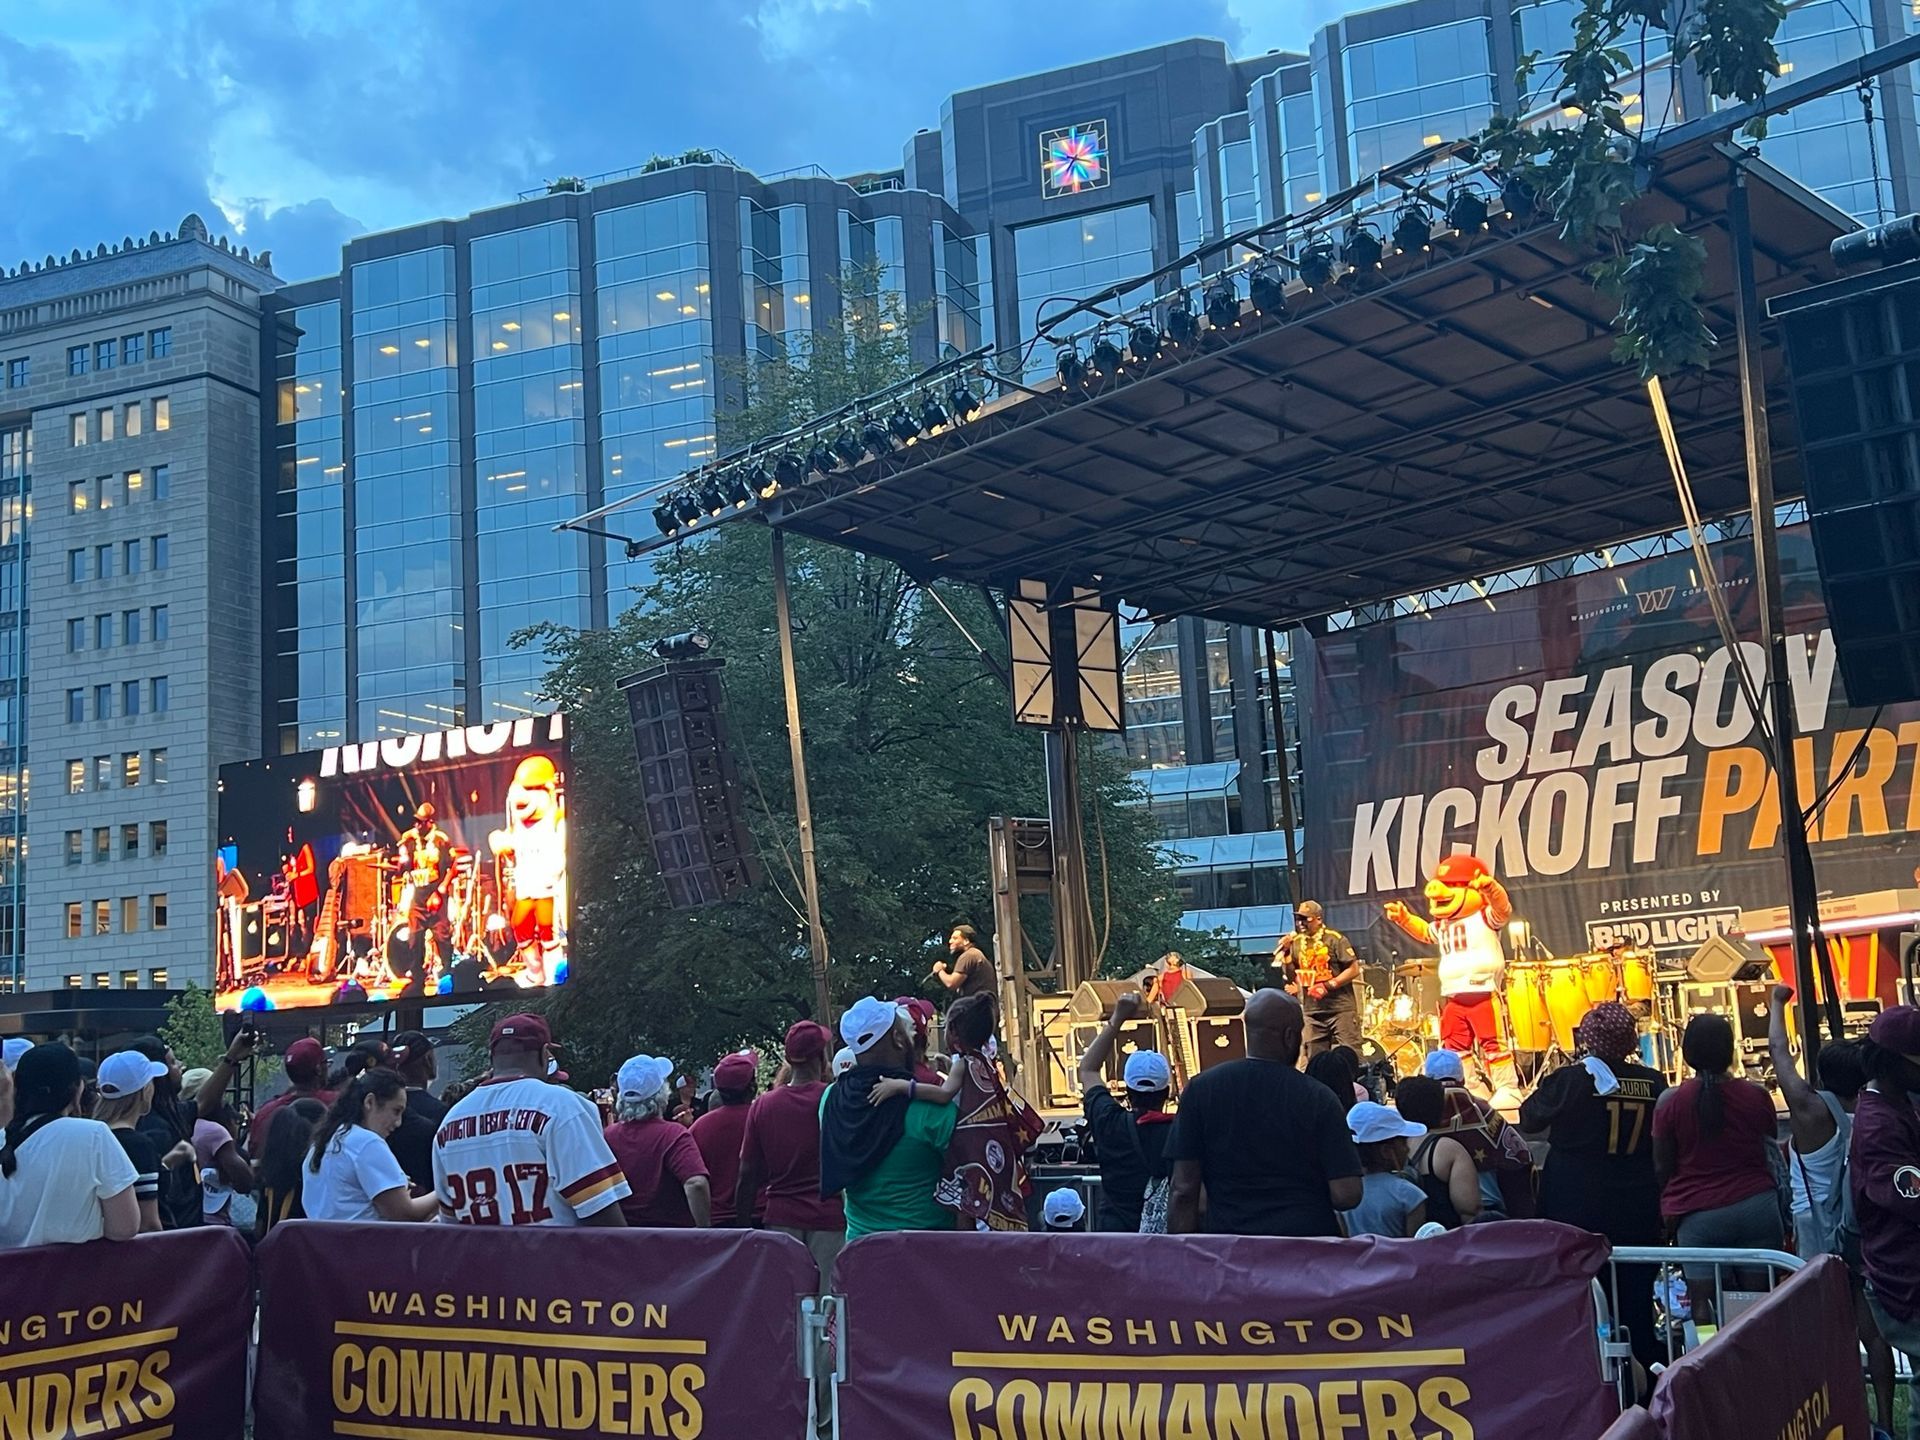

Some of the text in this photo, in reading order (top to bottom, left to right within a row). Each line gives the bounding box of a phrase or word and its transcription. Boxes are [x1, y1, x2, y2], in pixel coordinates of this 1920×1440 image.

[1571, 603, 1629, 622] WASHINGTON
[1475, 628, 1837, 782] SEASON
[1349, 755, 1689, 895] KICKOFF
[1600, 889, 1720, 914] PRESENTED BY
[1650, 913, 1737, 945] LIGHT
[1617, 1081, 1651, 1097] AURIN
[1606, 1101, 1646, 1155] 17
[368, 1290, 668, 1329] WASHINGTON
[998, 1313, 1415, 1346] WASHINGTON
[332, 1342, 705, 1440] COMMANDERS
[948, 1377, 1474, 1440] COMMANDERS
[1777, 1381, 1830, 1440] NGTON
